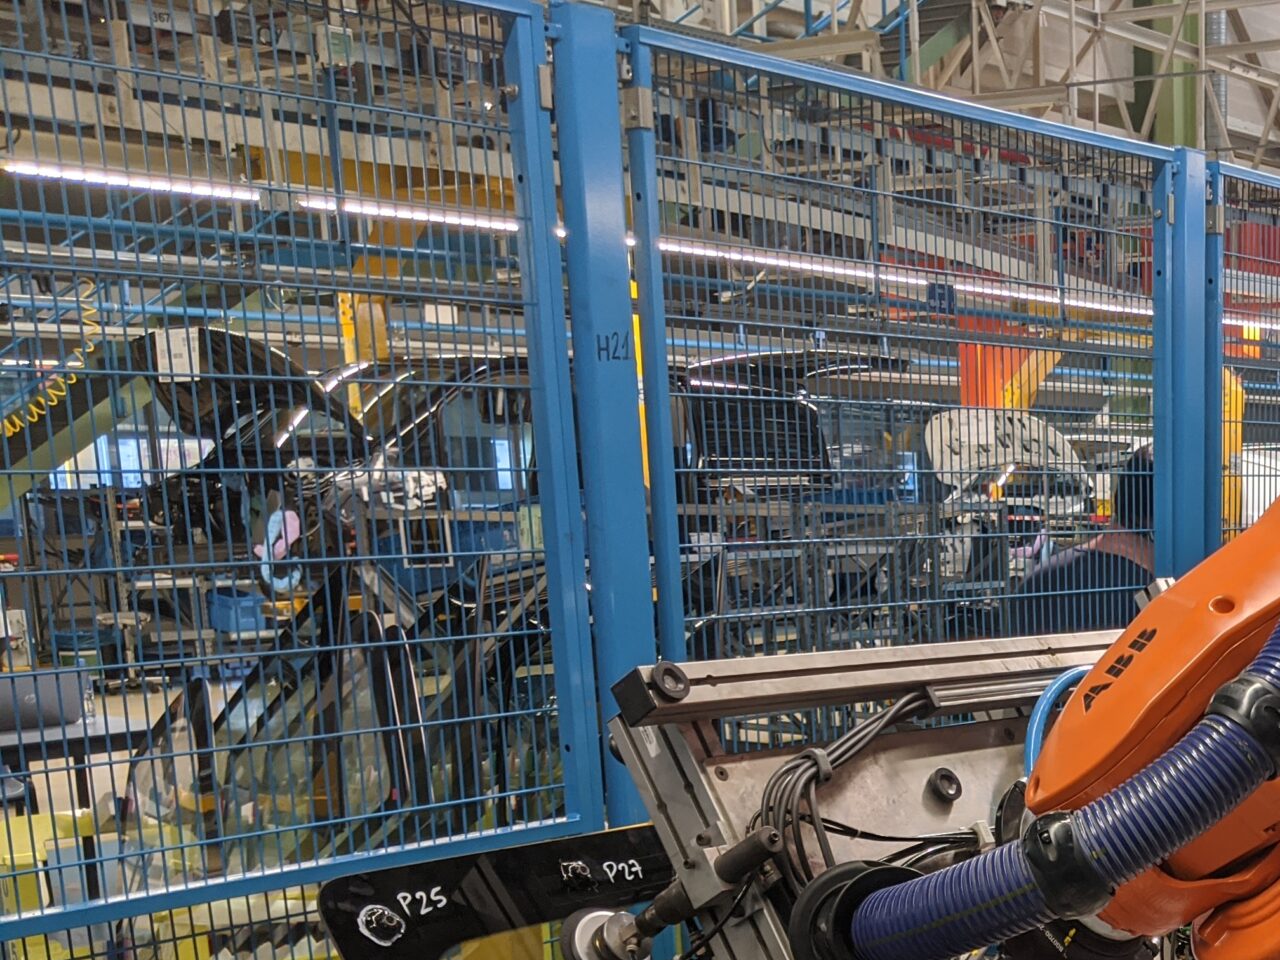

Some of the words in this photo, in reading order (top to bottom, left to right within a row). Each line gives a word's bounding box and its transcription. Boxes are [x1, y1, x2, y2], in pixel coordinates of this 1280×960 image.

[596, 330, 631, 362] H21
[1082, 628, 1158, 715] ABB
[602, 858, 643, 884] P27
[396, 885, 449, 918] P25
